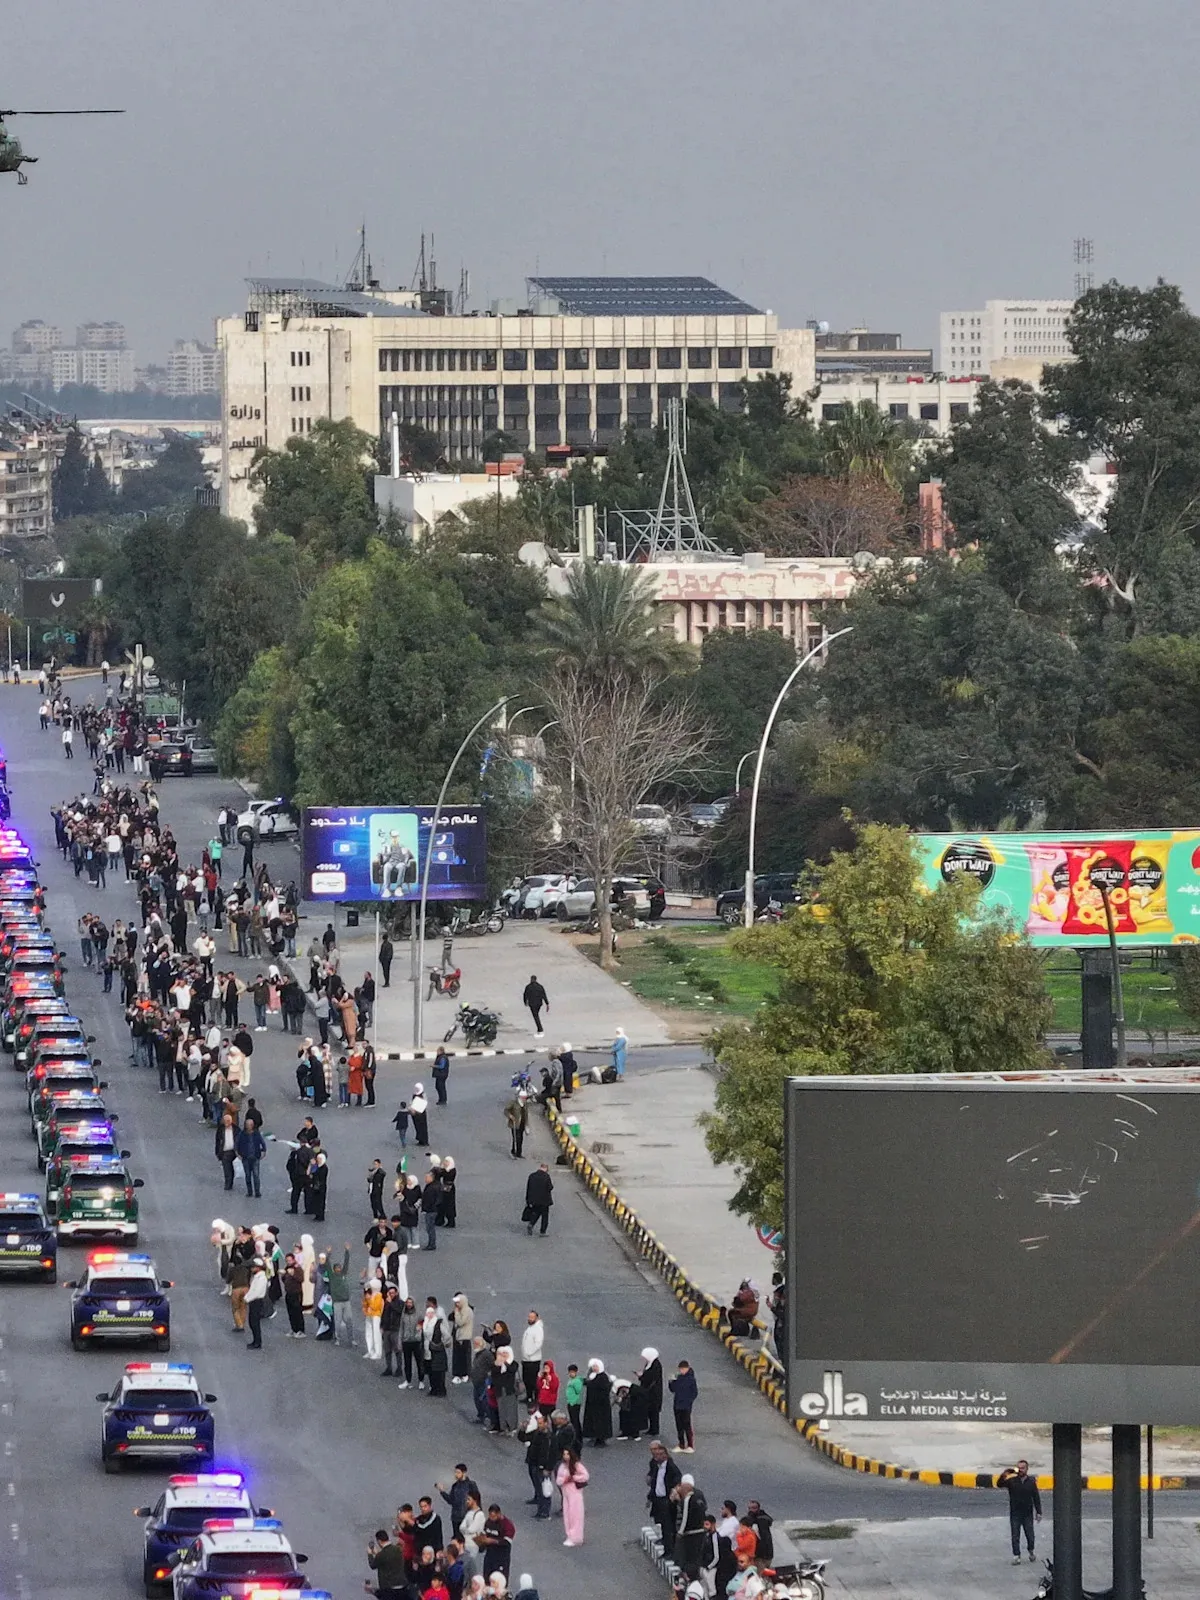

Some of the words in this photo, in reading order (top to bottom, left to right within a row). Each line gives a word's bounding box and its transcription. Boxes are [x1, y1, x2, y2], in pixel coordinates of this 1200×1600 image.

[230, 404, 261, 420] وزارة
[229, 435, 263, 452] التعليم
[310, 817, 348, 828] حدود
[349, 815, 366, 827] بلا
[451, 813, 478, 826] عالم
[800, 1370, 868, 1416] ella
[921, 1389, 959, 1400] للخدمات
[980, 1388, 1007, 1403] شركة
[880, 1405, 907, 1415] ELLA
[911, 1405, 949, 1416] MEDIA
[952, 1406, 1008, 1417] SERVICES
